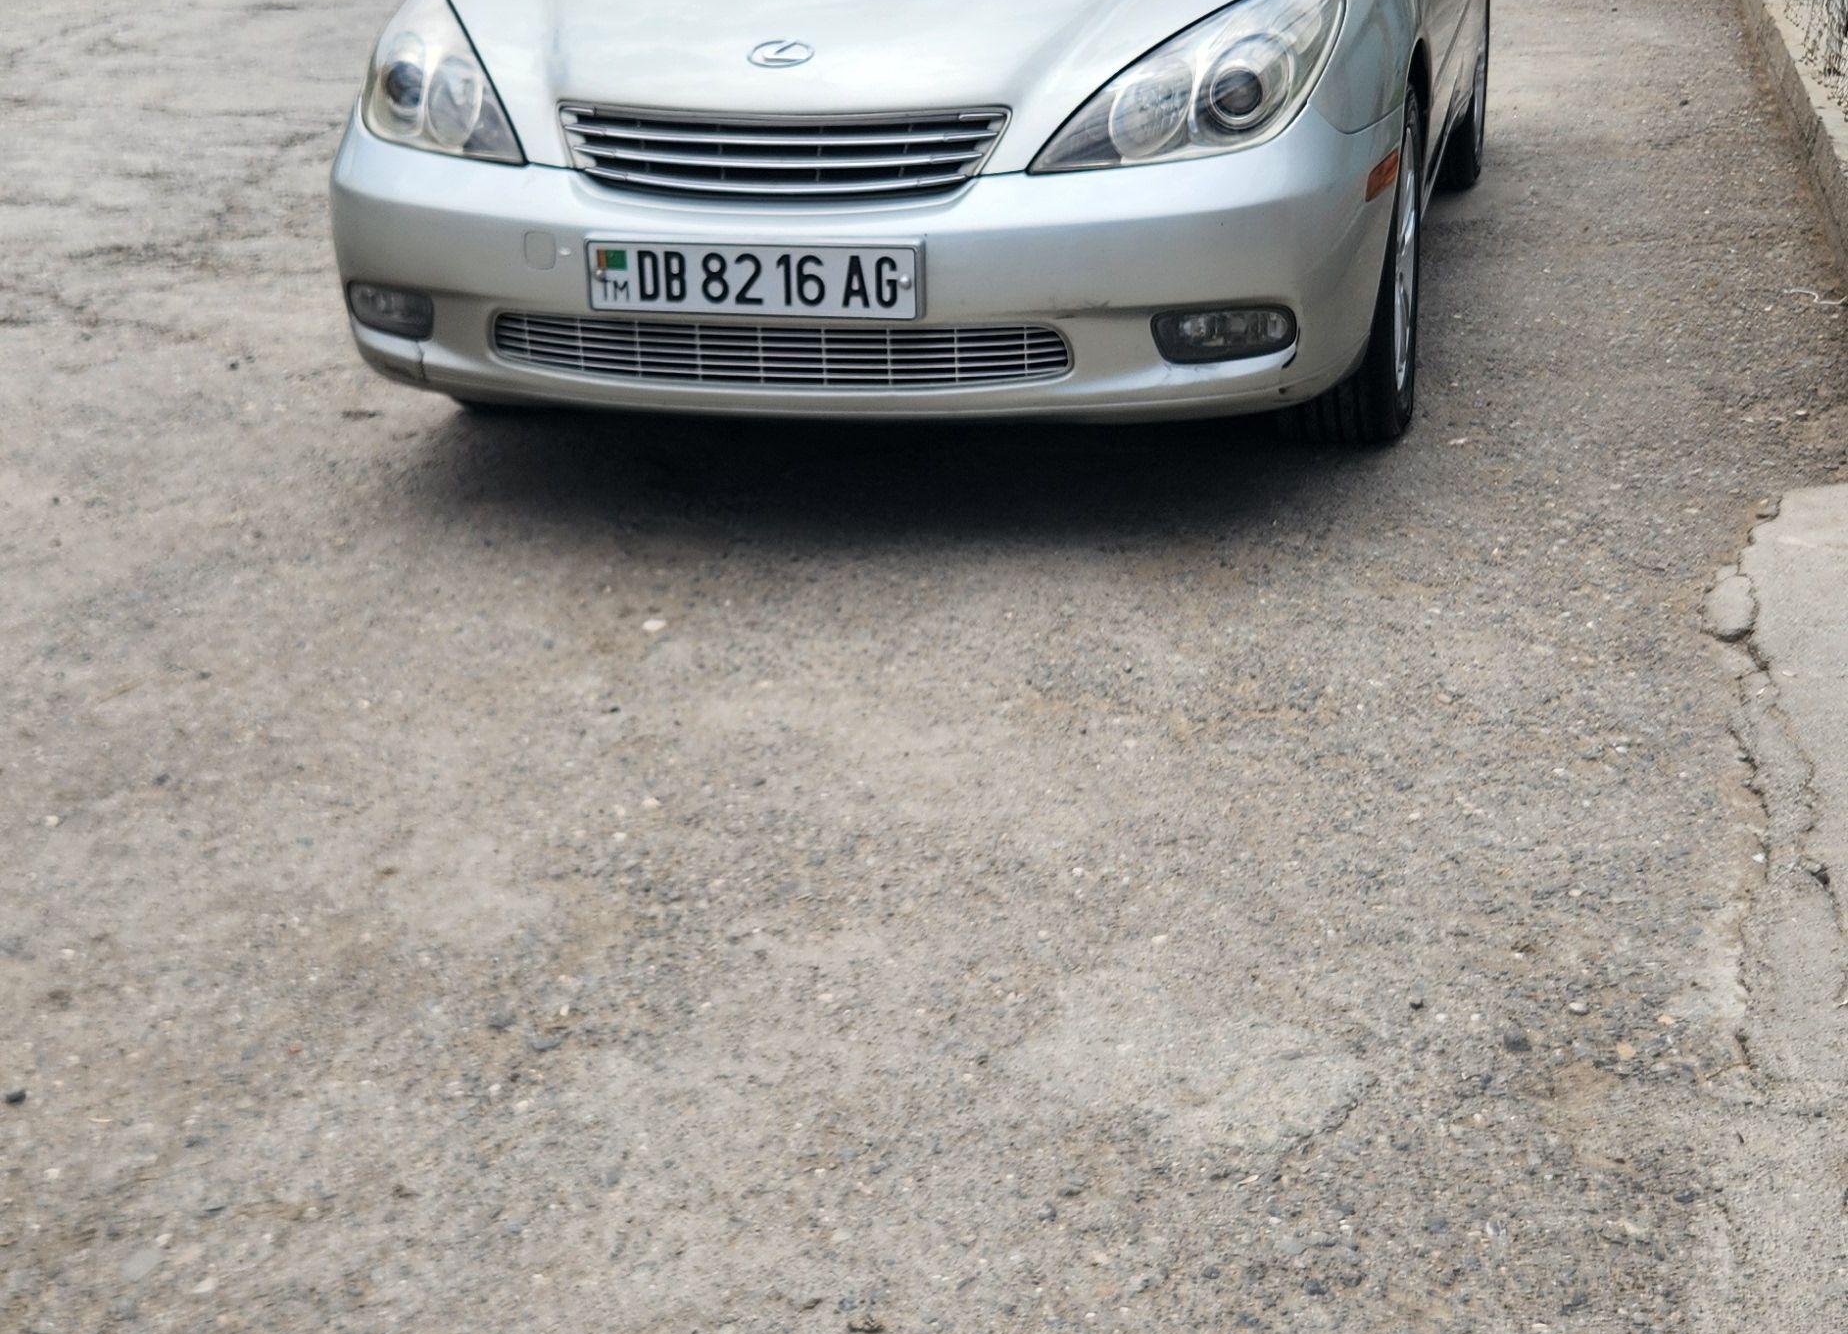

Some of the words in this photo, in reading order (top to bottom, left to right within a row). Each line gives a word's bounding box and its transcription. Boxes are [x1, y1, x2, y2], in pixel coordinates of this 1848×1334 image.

[601, 278, 629, 302] TM
[637, 250, 687, 302] DB
[842, 255, 898, 308] AG
